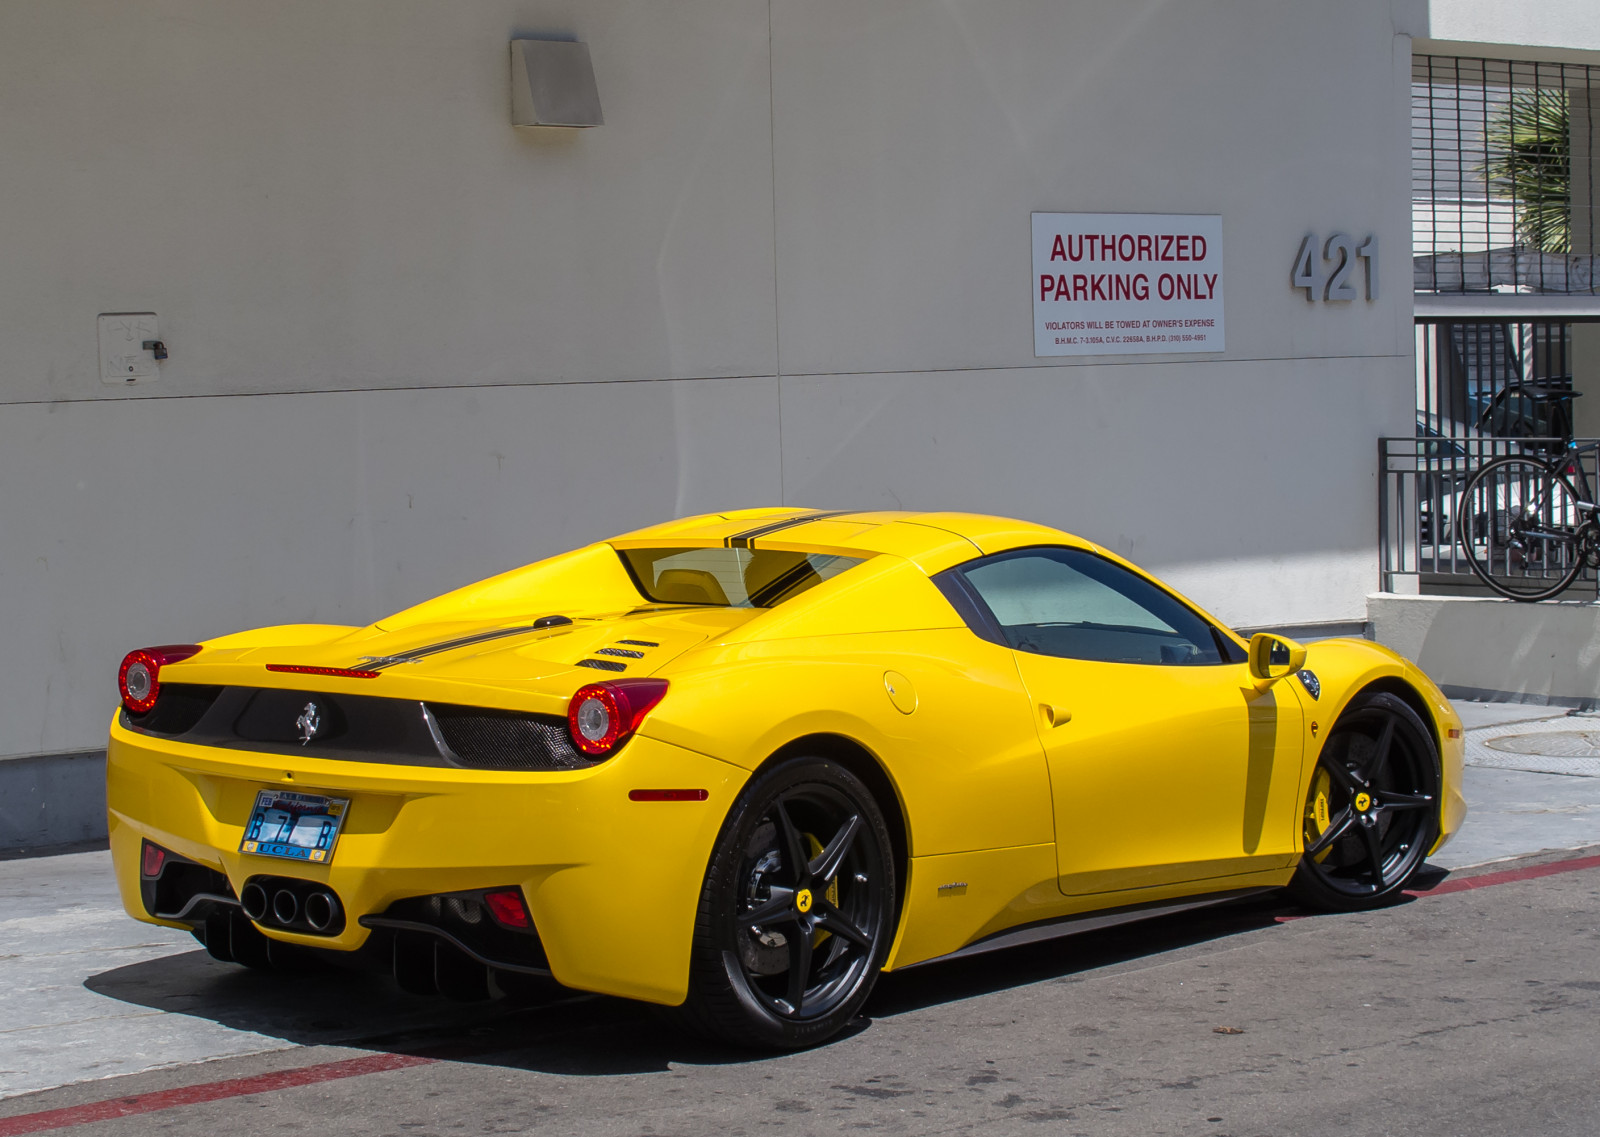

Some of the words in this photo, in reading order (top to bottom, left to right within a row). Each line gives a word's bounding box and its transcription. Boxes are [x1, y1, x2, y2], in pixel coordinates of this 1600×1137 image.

[1050, 234, 1207, 262] AUTHORIZED
[1289, 233, 1379, 301] 421
[1040, 273, 1150, 301] PARKING
[1157, 273, 1218, 301] ONLY
[1045, 321, 1085, 330] VIOLATORS
[1086, 321, 1103, 329] WILL
[1104, 321, 1114, 329] BE
[1116, 320, 1140, 329] TOWED
[1142, 320, 1150, 328] AT
[1152, 319, 1183, 328] OWNER'S
[1184, 319, 1215, 327] EXPENSE
[1168, 334, 1181, 343] (310)
[1182, 334, 1206, 342] 550-4951
[259, 845, 308, 858] UCLA
